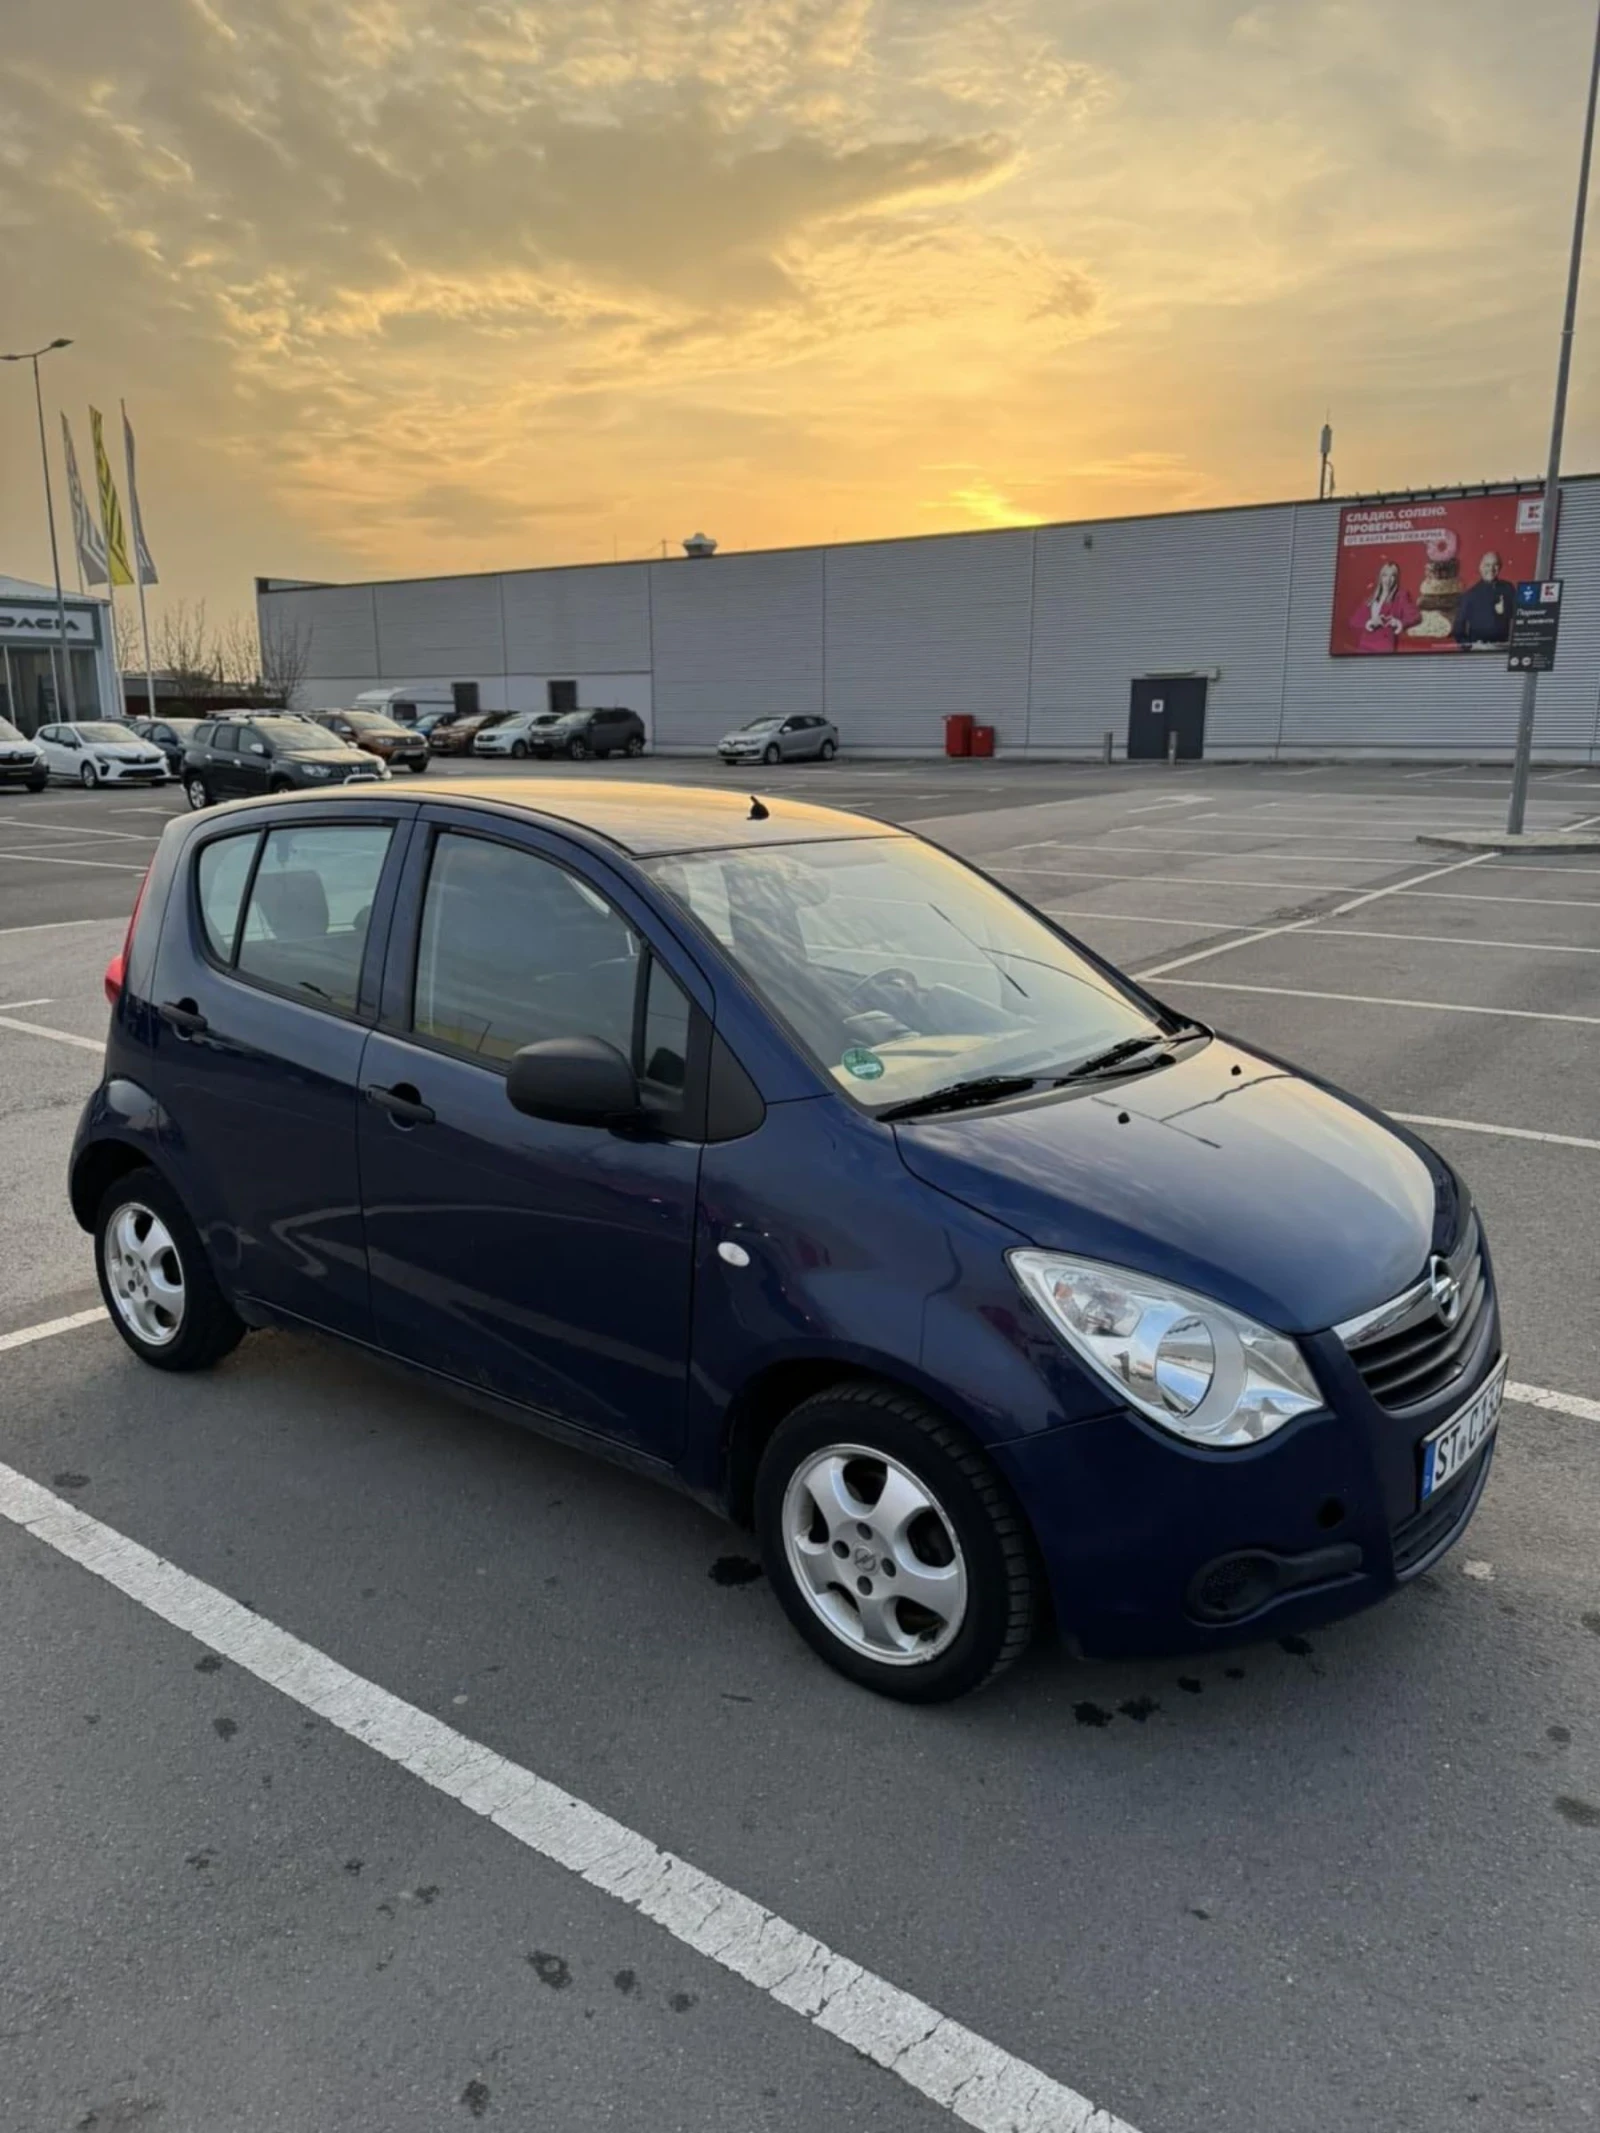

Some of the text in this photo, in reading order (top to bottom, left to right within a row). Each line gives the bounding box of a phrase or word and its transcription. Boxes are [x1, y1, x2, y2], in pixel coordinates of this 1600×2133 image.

[1346, 506, 1448, 523] СЛАДКО. СОЛЕНО.
[1345, 520, 1414, 534] ПРОВЕРЕНО.
[1435, 1425, 1461, 1481] ST
